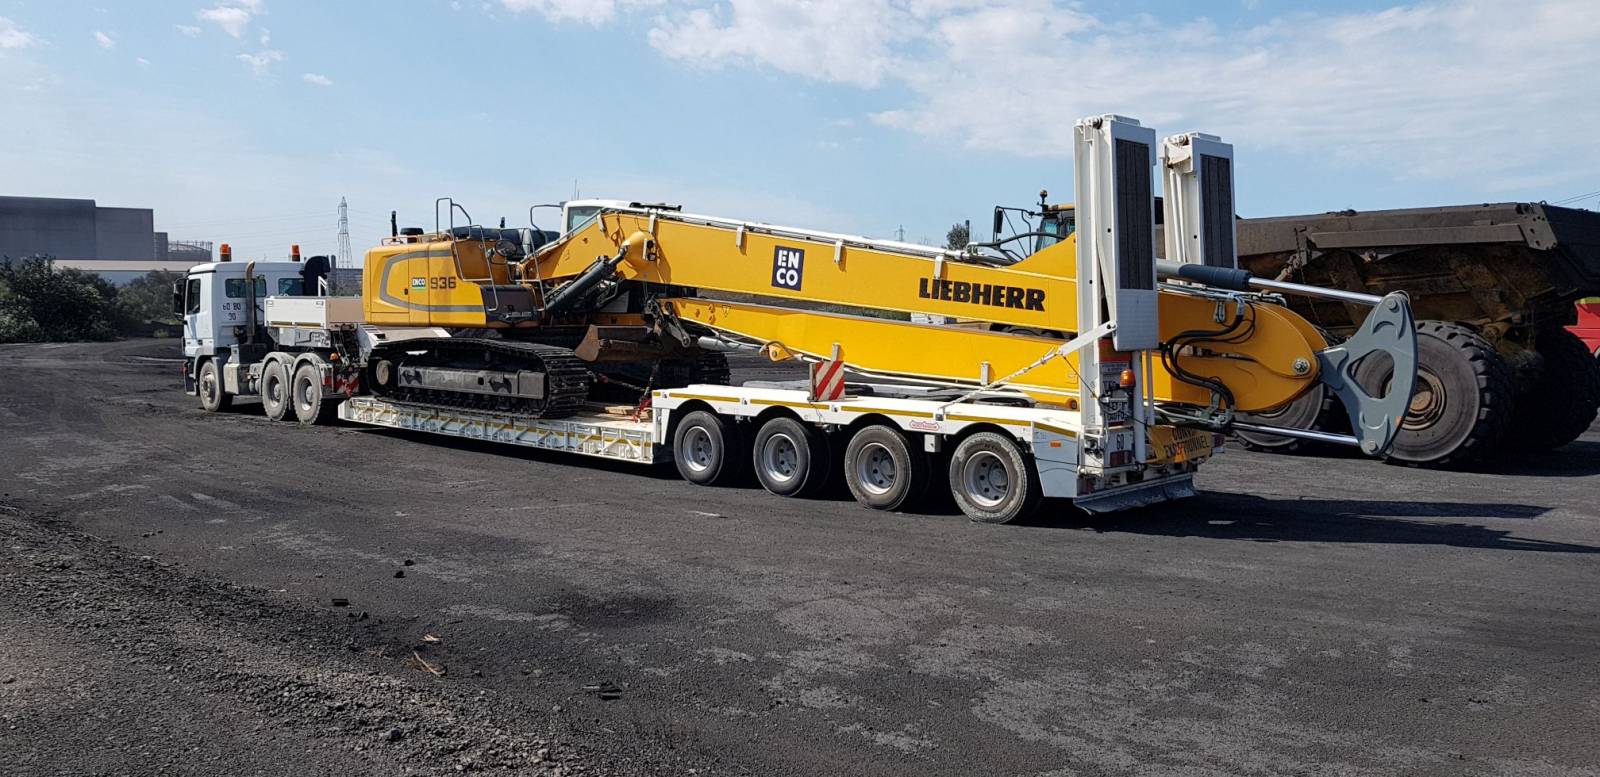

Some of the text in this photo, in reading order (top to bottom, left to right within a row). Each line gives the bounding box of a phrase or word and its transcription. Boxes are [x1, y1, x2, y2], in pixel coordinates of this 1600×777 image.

[777, 249, 800, 269] EN
[430, 277, 456, 289] 936
[776, 268, 799, 286] CO
[919, 277, 1046, 312] LIEBHERR
[1164, 433, 1210, 459] EXCTIONNEL
